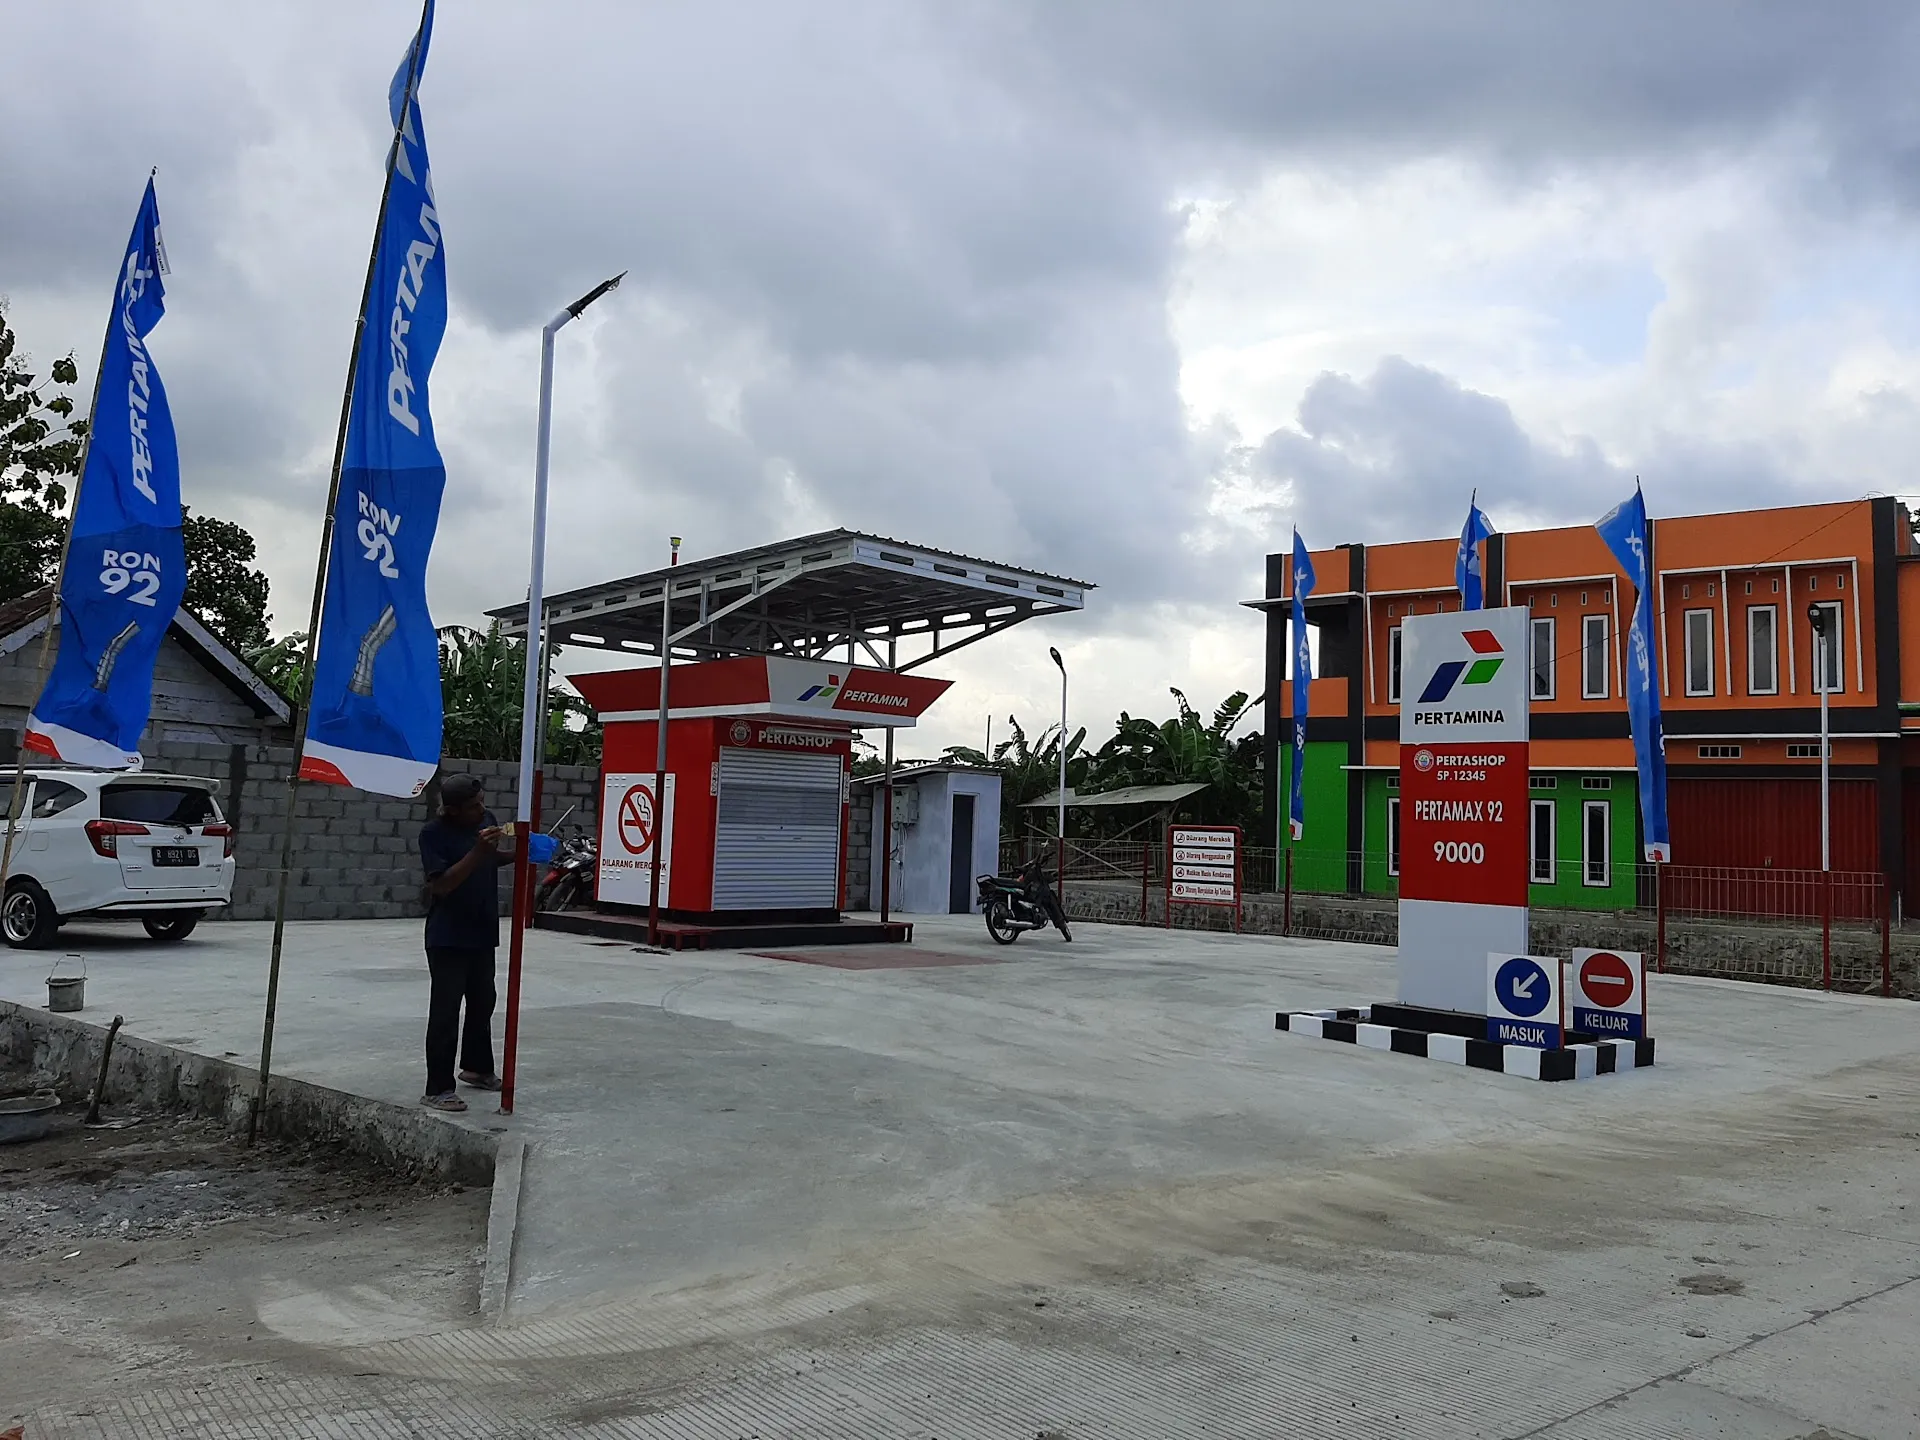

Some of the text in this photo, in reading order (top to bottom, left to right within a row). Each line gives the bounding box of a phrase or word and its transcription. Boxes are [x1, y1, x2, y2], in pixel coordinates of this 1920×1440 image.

[387, 95, 441, 437] PERTAM
[357, 489, 402, 537] RON
[357, 518, 400, 580] 92
[102, 549, 161, 573] RON
[99, 569, 160, 608] 92
[843, 689, 909, 708] PERTAMINA
[1414, 709, 1505, 725] PERTAMINA
[758, 730, 834, 748] PERTASHOP
[1436, 755, 1506, 766] PERTASHOP
[1415, 800, 1503, 822] PERTAMAX 92
[1433, 841, 1485, 864] 9000
[602, 858, 667, 872] DILARANG MEROK
[1585, 1013, 1629, 1032] KELUAR
[1499, 1024, 1546, 1044] MASUK
